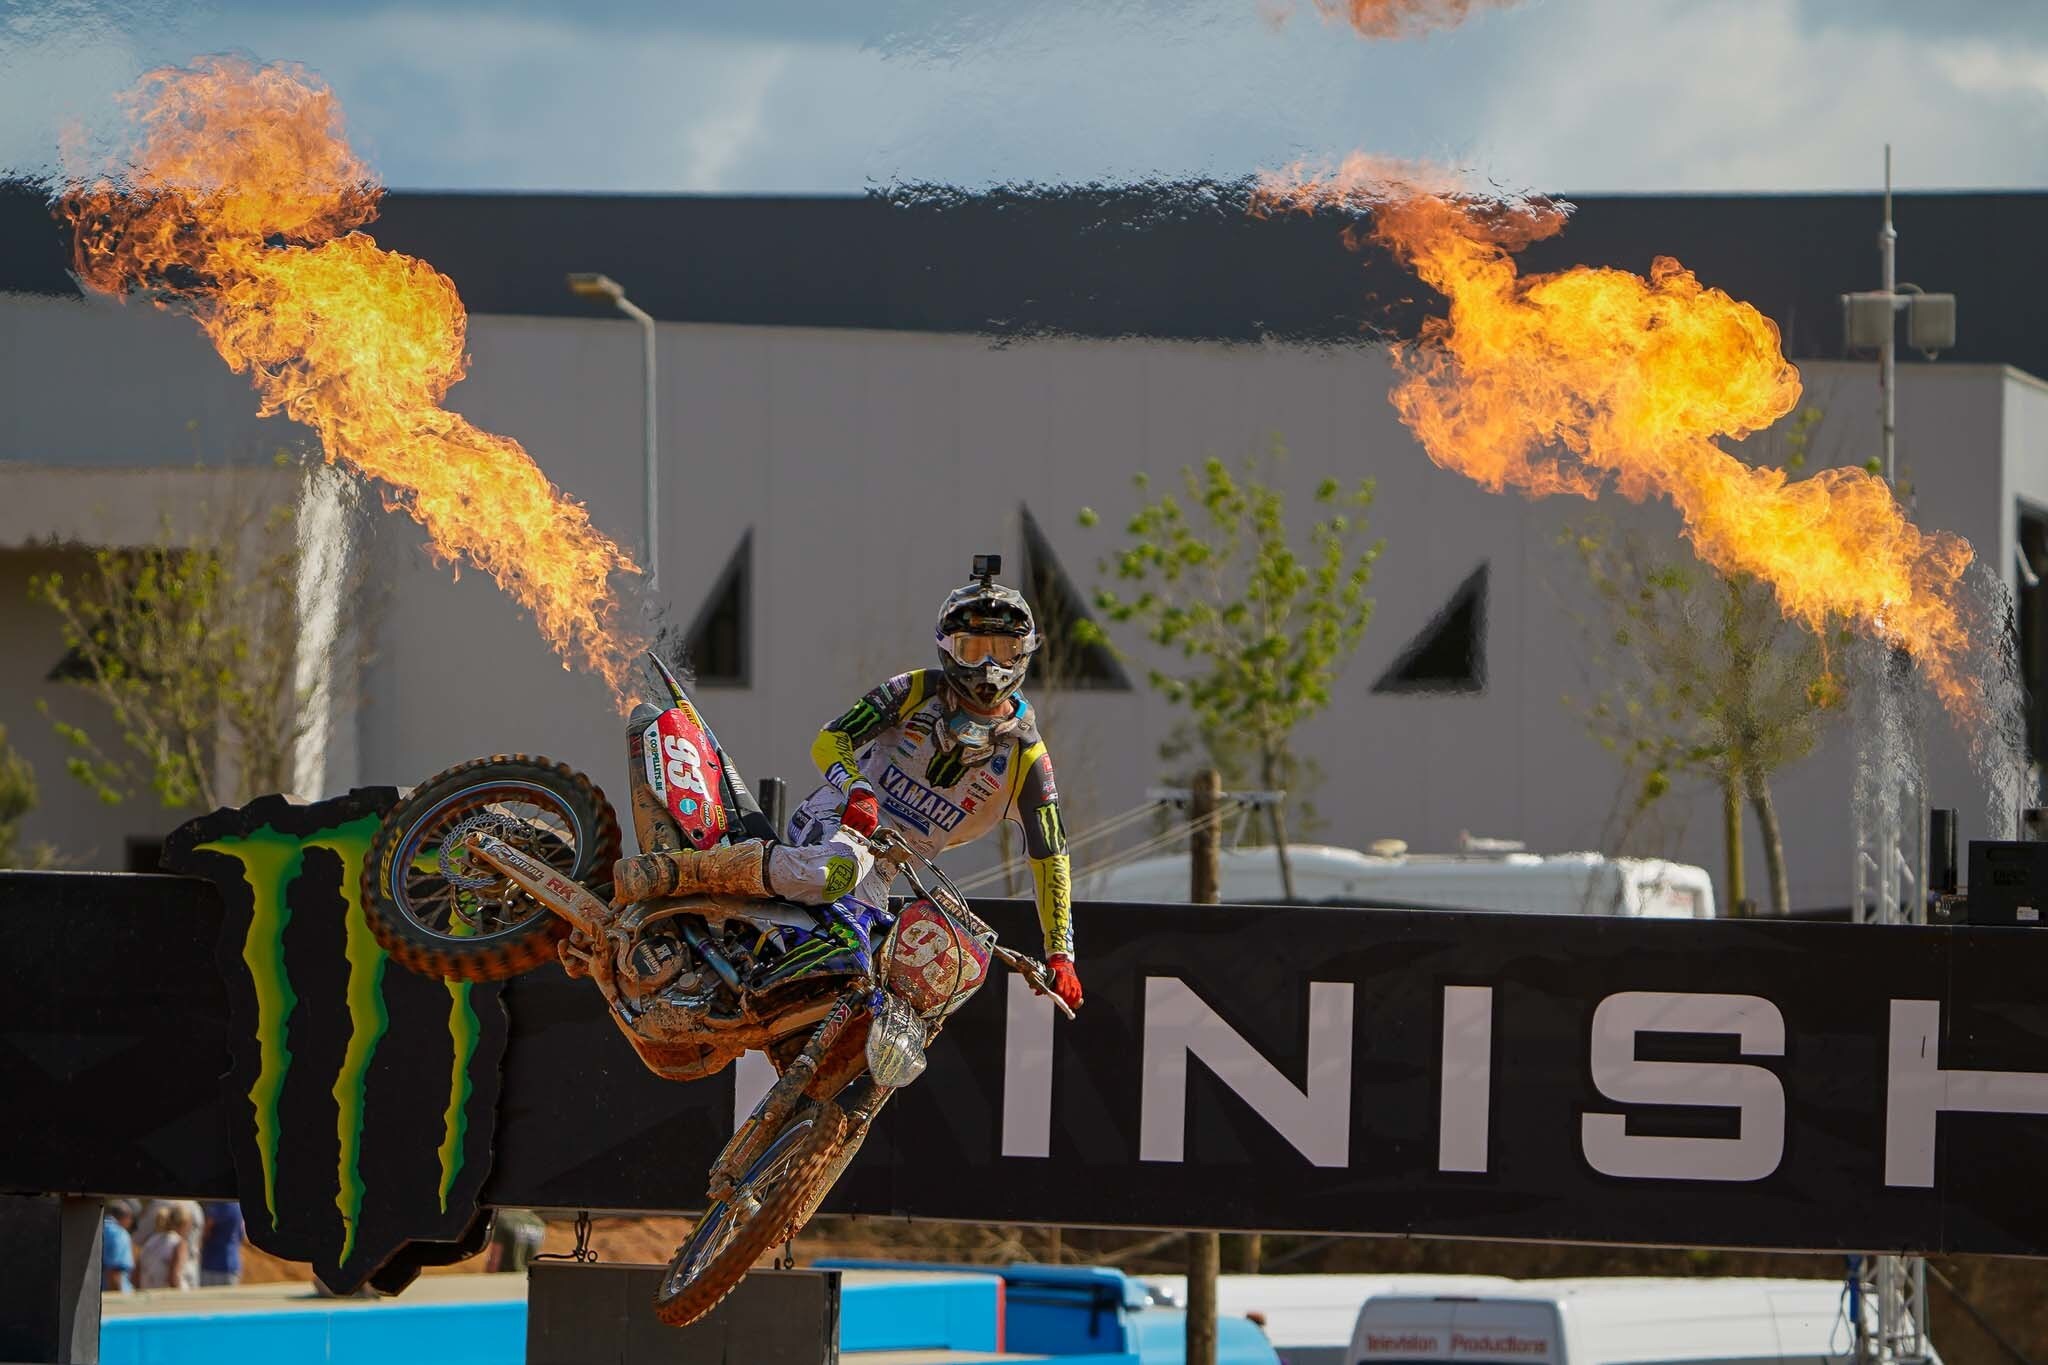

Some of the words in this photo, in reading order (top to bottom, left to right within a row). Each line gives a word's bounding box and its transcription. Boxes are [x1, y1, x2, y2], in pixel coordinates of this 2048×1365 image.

[663, 735, 712, 801] 93
[723, 765, 747, 796] YAMAHA
[882, 769, 965, 831] YAMAHA
[546, 879, 577, 903] RK
[1367, 1333, 1438, 1353] Television
[1451, 1333, 1548, 1355] Productions
